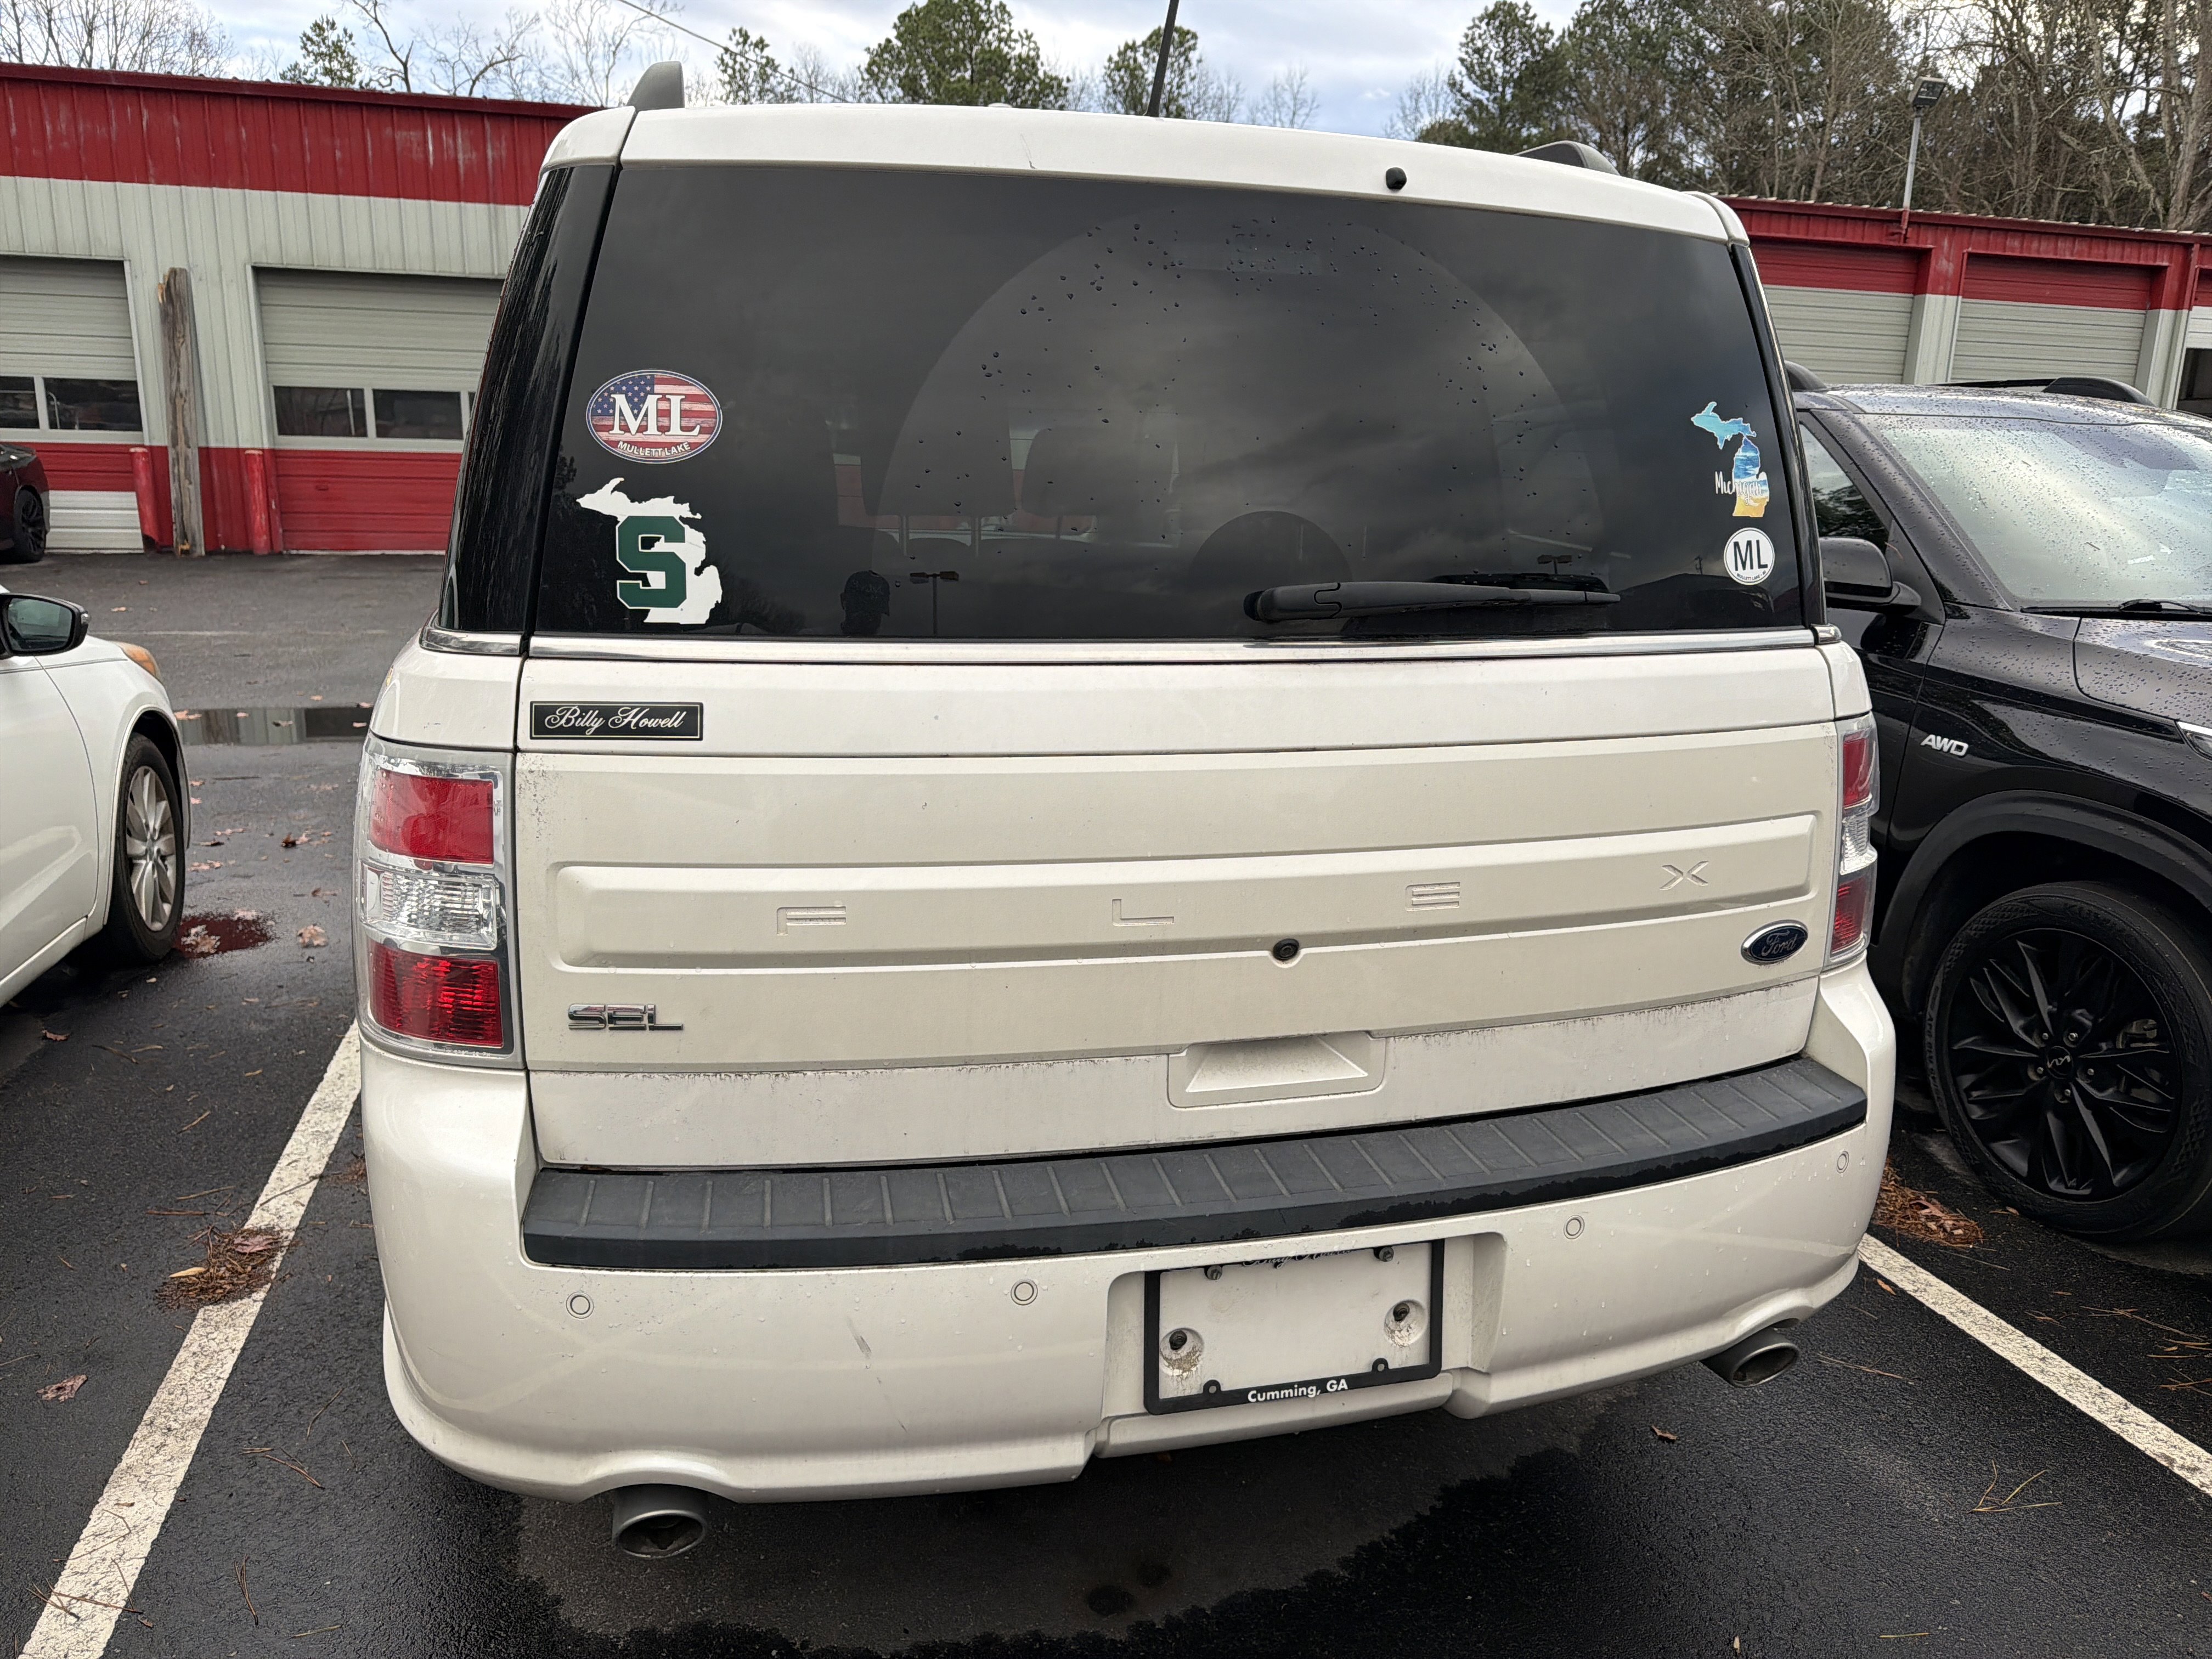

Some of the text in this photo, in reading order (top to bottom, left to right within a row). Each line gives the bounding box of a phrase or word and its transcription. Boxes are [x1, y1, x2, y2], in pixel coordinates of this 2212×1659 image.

[608, 393, 701, 436] ML
[617, 440, 691, 456] MULLETT LAKE
[1715, 471, 1764, 506] Michigan
[617, 515, 687, 609] S
[1733, 539, 1768, 572] ML
[545, 706, 687, 735] Billy Howell
[1920, 734, 1969, 757] AWD
[776, 860, 1709, 936] FLEX
[1761, 929, 1798, 957] Ford
[568, 1003, 684, 1031] SEL
[1247, 1379, 1348, 1402] Cumming, GA
